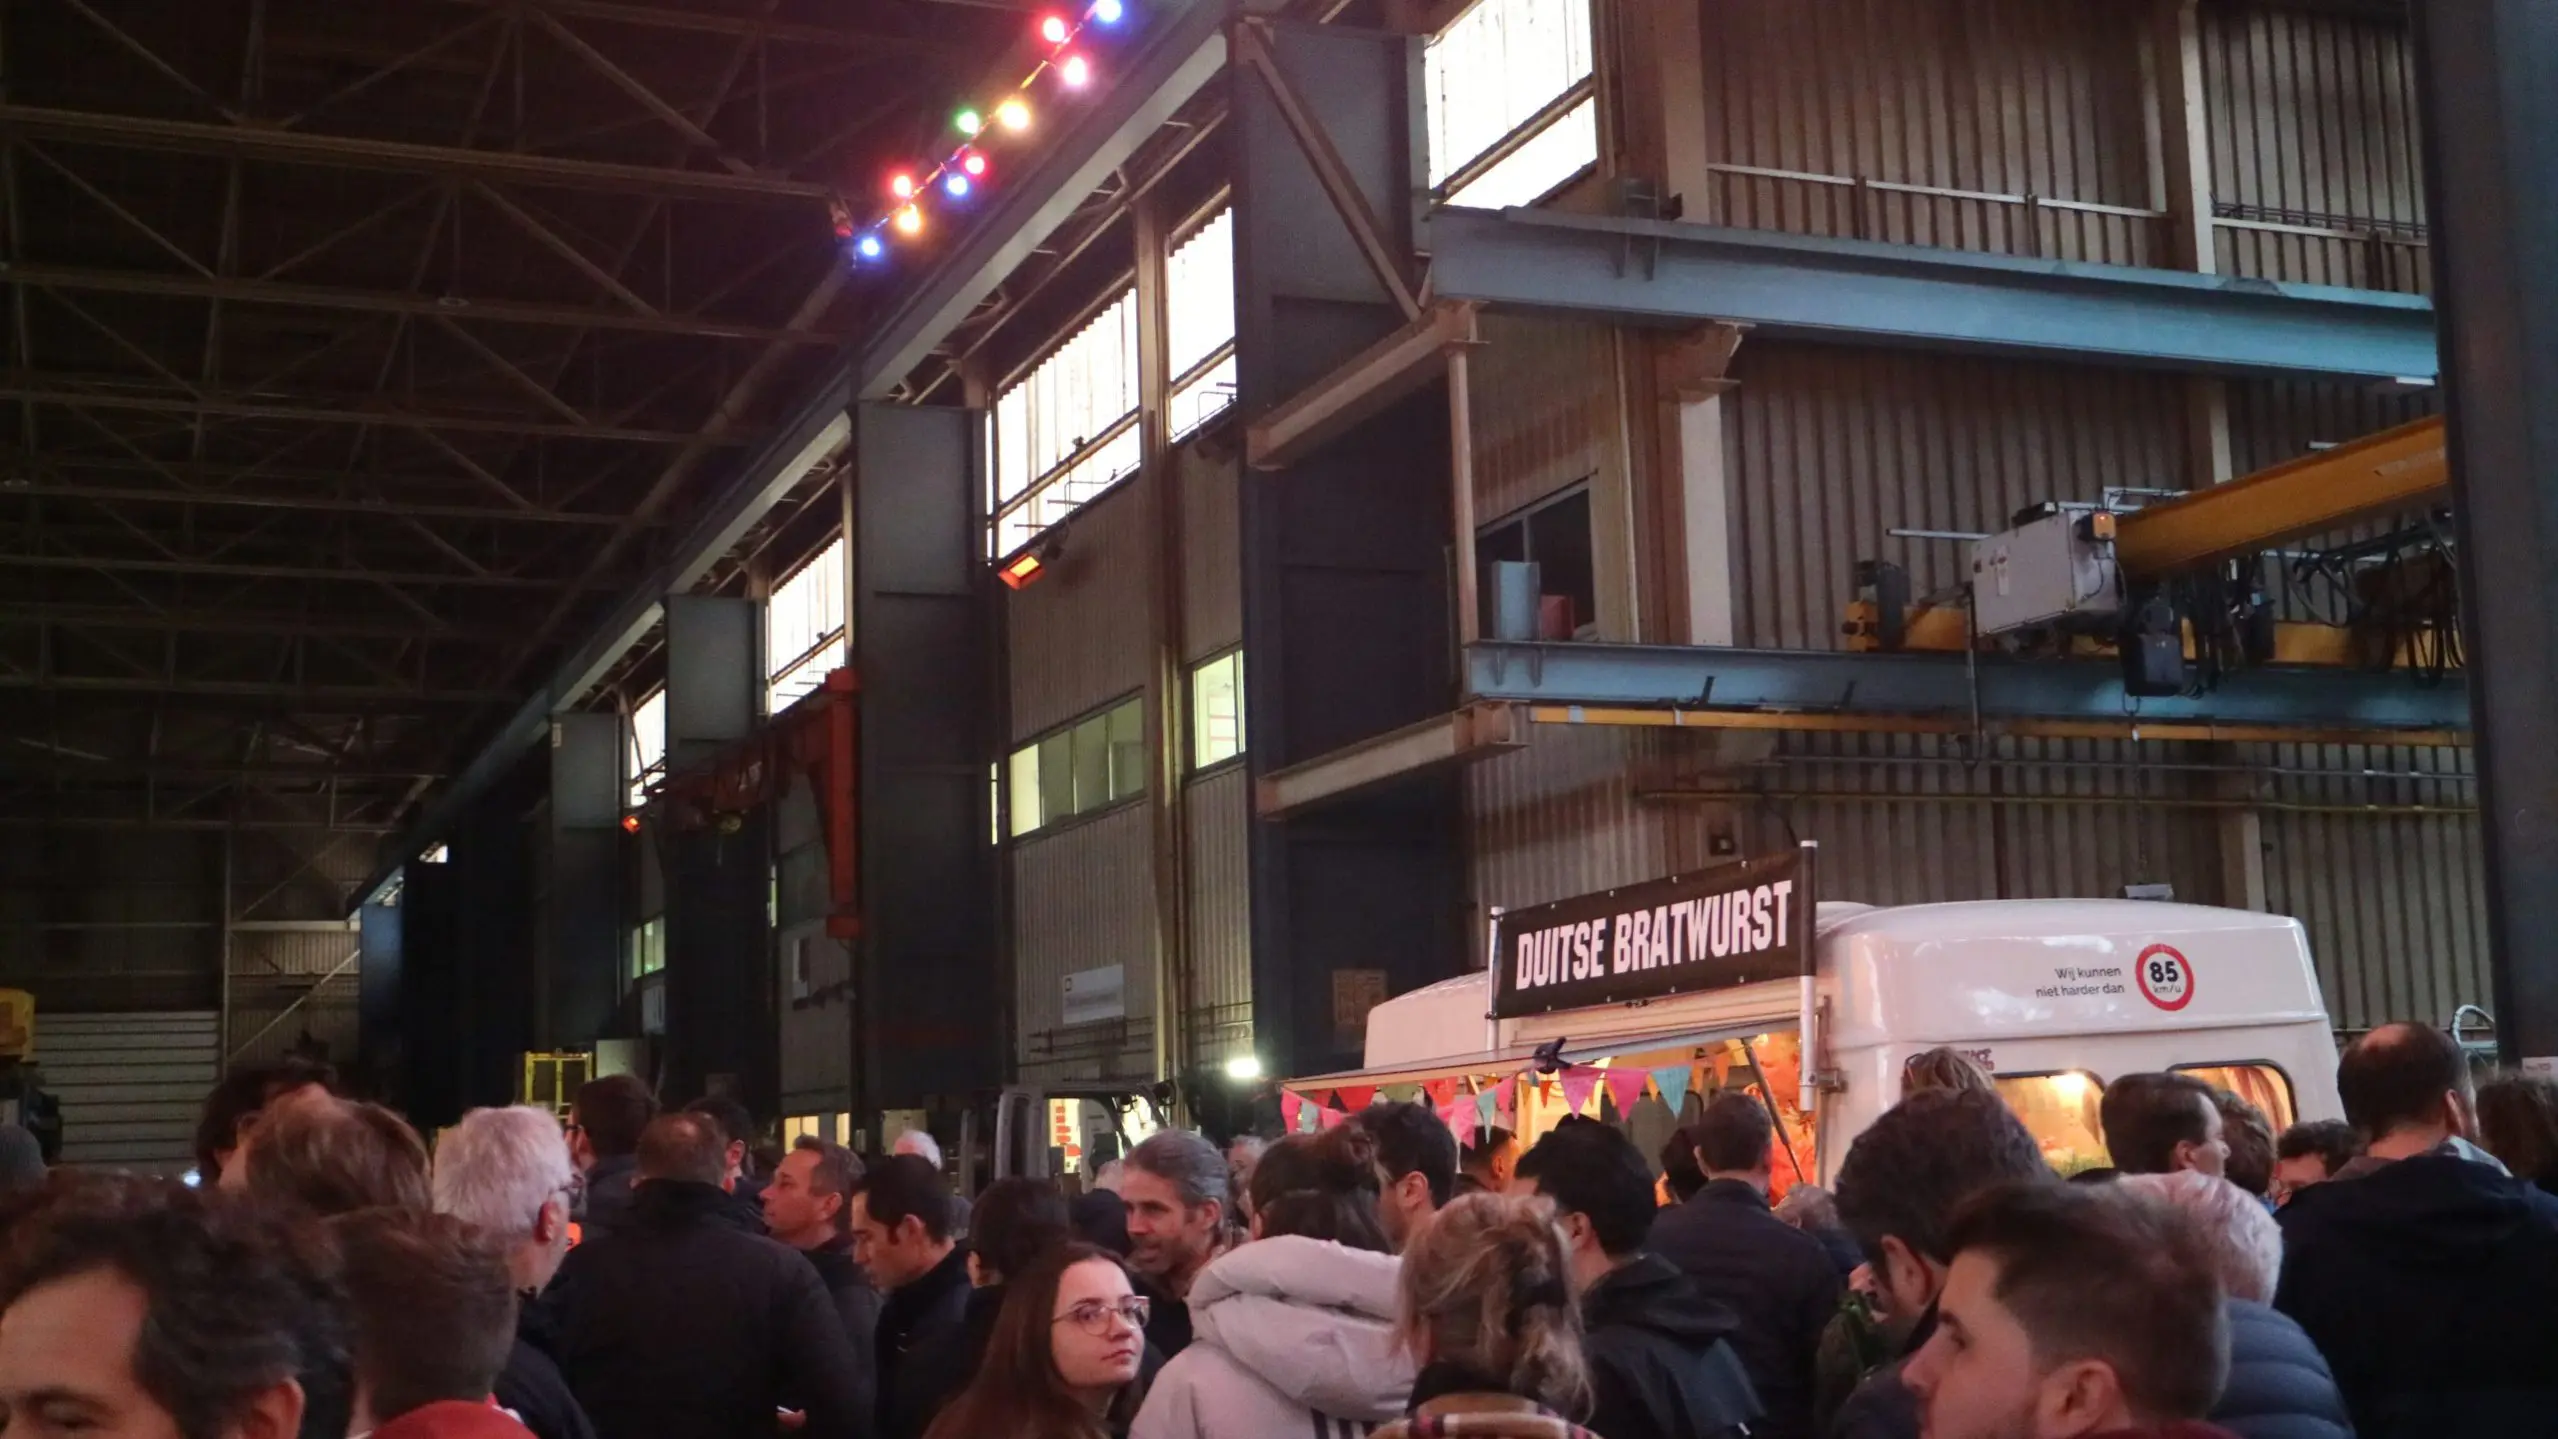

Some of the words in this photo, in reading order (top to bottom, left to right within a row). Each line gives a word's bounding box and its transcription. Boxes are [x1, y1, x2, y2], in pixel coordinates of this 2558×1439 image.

[1516, 917, 1606, 990] DUITSE
[1613, 880, 1792, 974] BRATWURST
[2054, 968, 2077, 981] Wij
[2077, 967, 2122, 978] kunnen
[2150, 961, 2178, 983] 85
[2036, 985, 2059, 998] niet
[2060, 984, 2100, 997] harder
[2102, 983, 2125, 994] dan
[2153, 985, 2182, 994] km/u
